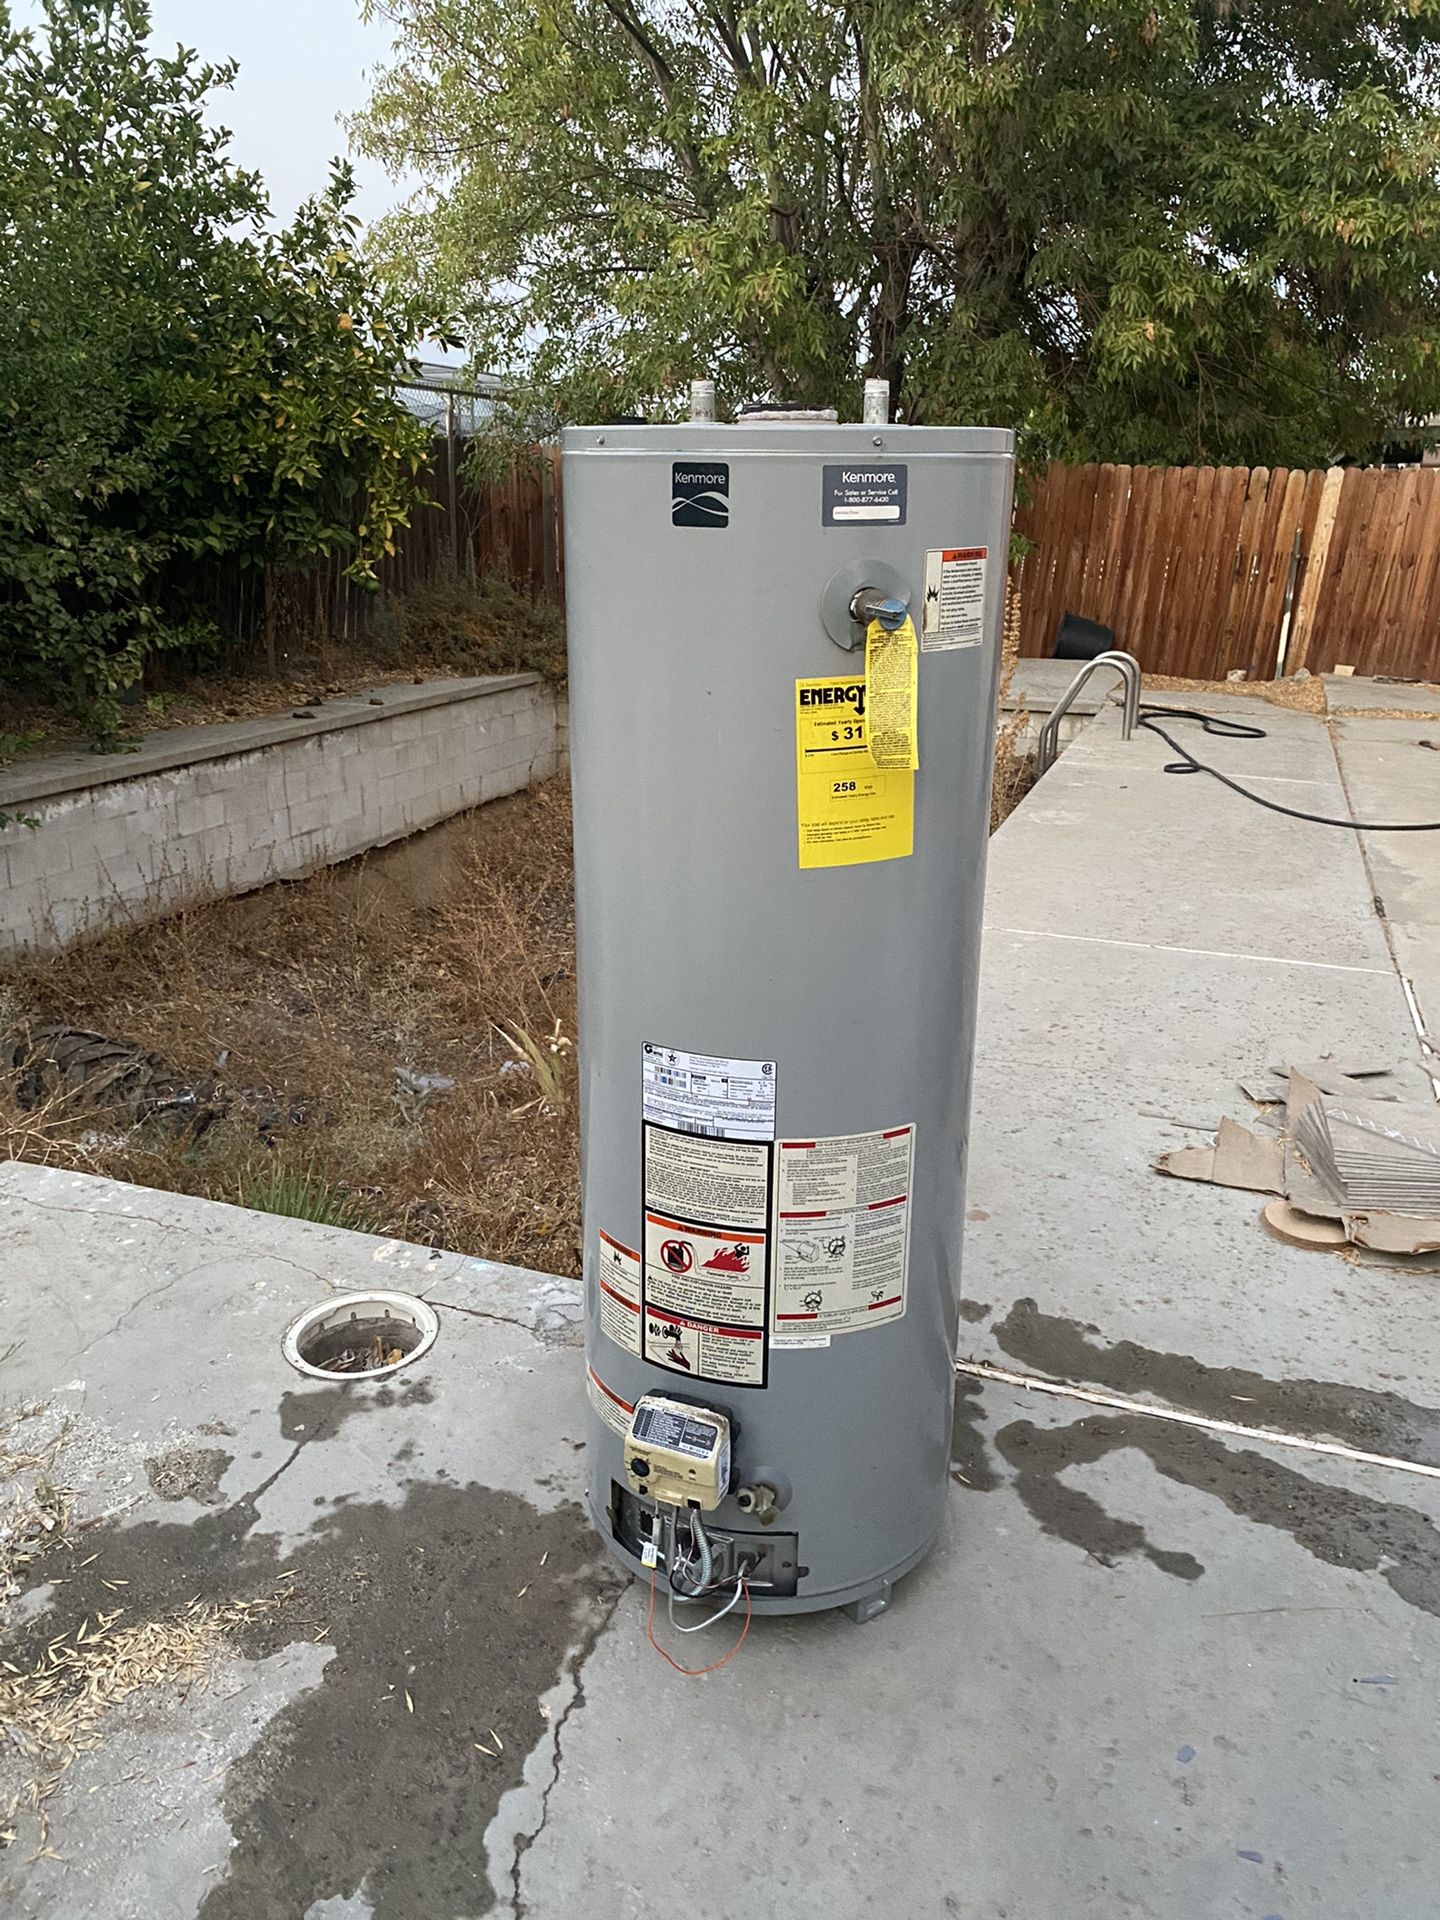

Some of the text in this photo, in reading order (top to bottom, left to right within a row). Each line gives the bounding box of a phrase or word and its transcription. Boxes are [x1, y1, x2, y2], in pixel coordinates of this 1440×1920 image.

[675, 472, 726, 484] Kenmore
[842, 471, 895, 483] Kenmore
[888, 488, 898, 496] Call
[831, 730, 839, 741] $
[833, 781, 856, 792] 258
[685, 1226, 722, 1239] WARNING
[687, 1321, 720, 1333] DANGER
